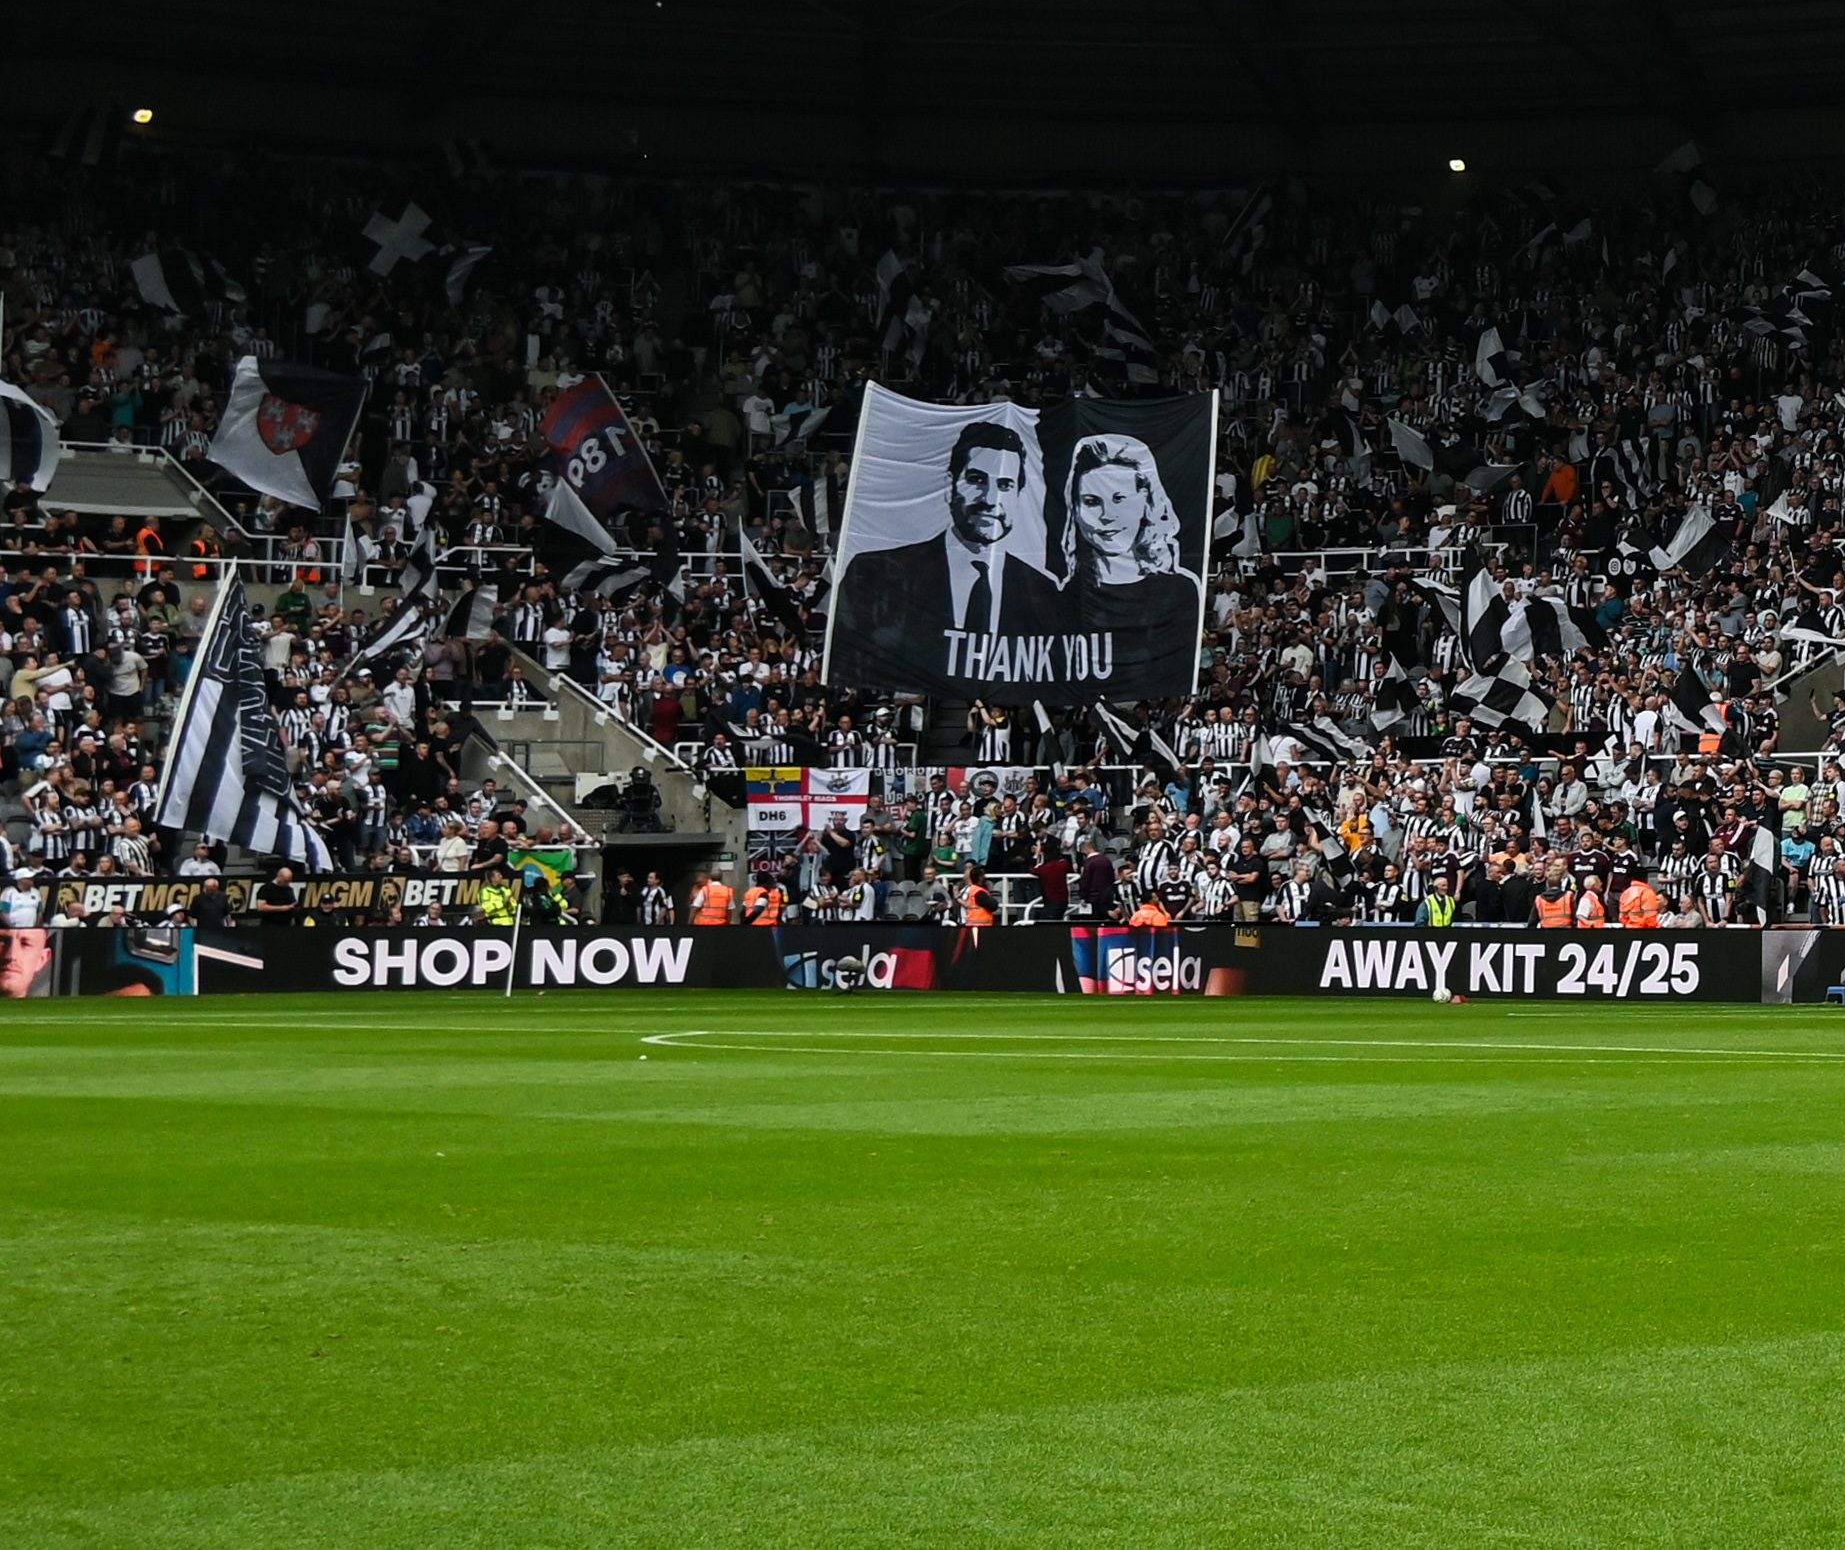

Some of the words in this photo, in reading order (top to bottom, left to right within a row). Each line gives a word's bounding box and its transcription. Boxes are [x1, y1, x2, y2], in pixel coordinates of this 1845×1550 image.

[943, 629, 1055, 683] THANK
[1062, 632, 1113, 681] YOU
[759, 811, 786, 821] DH6
[332, 937, 512, 986] SHOP
[530, 937, 695, 985] NOW
[1135, 946, 1202, 992] sela
[1319, 940, 1457, 990] AWAY
[1470, 942, 1544, 993] KIT
[1557, 941, 1700, 996] 24/25
